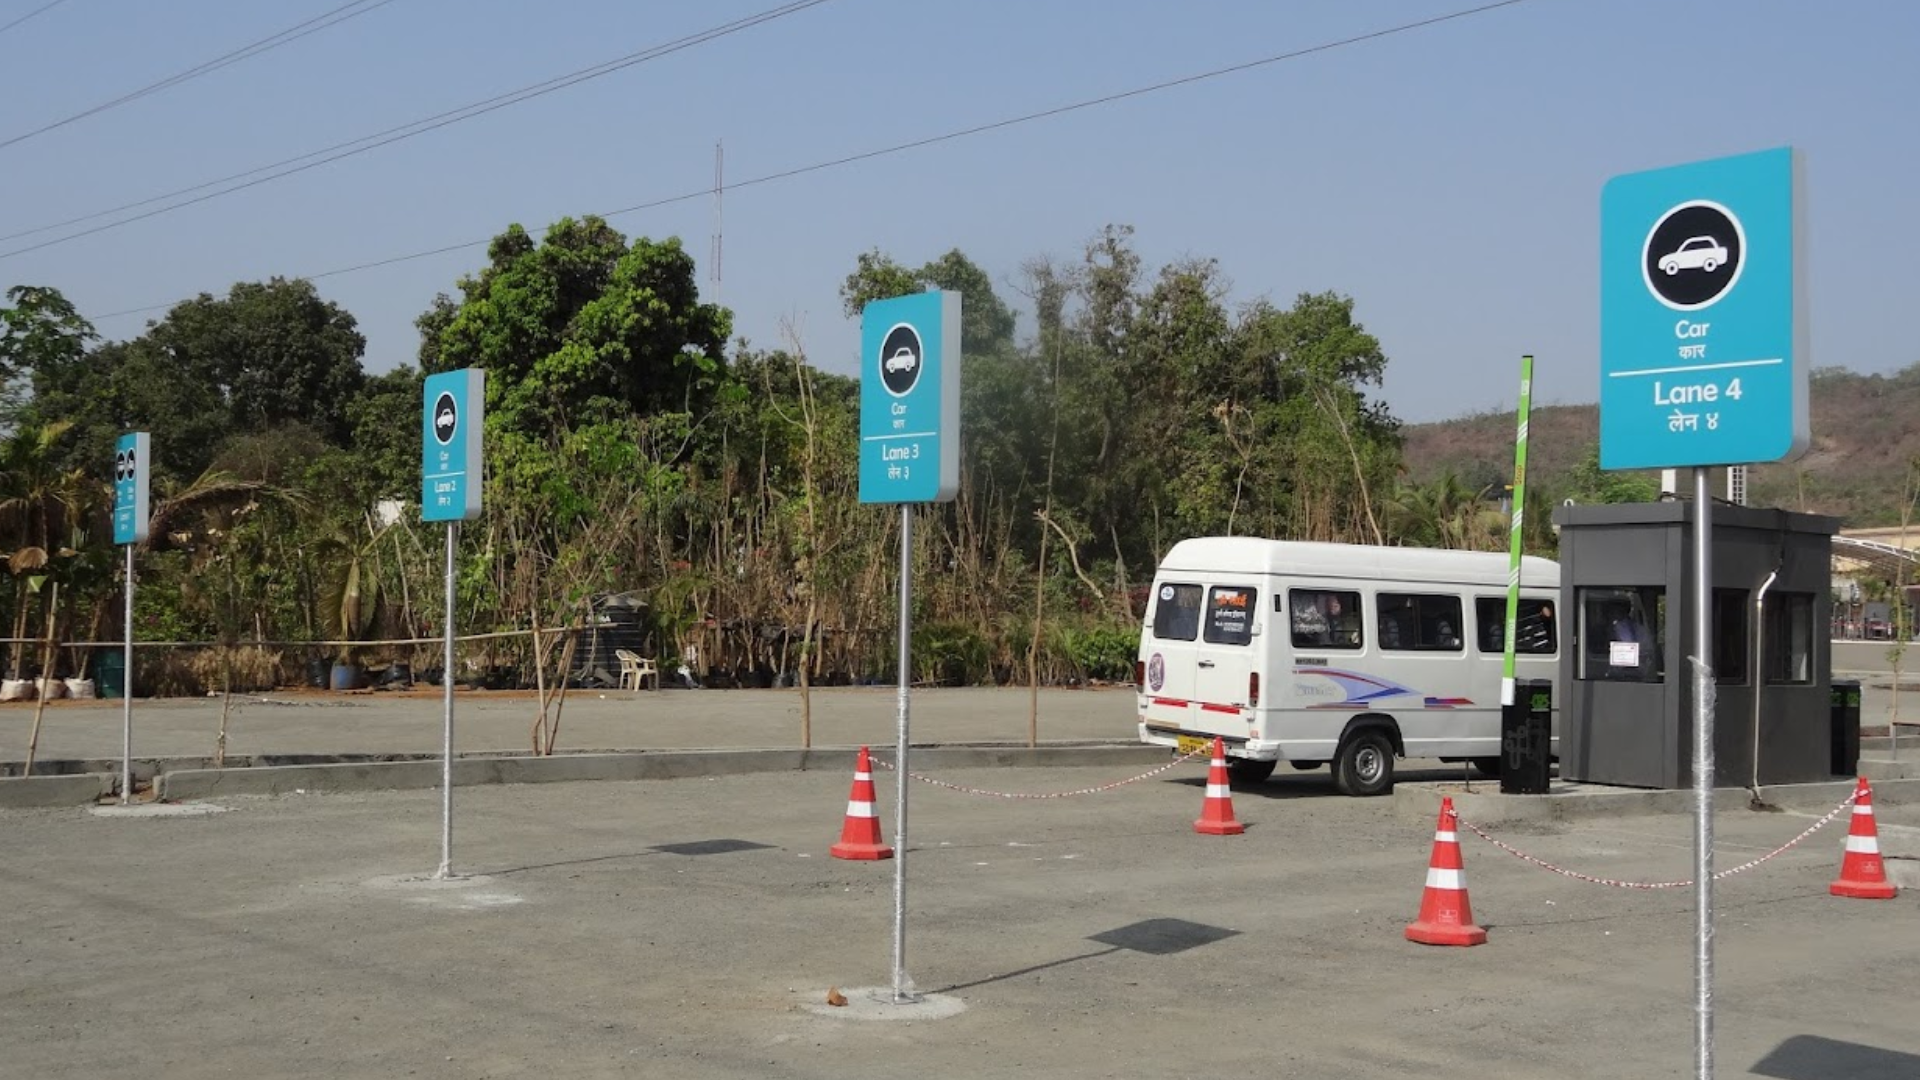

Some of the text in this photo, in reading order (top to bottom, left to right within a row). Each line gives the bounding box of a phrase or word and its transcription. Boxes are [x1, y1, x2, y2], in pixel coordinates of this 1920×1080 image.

[1675, 320, 1710, 339] Car
[1678, 344, 1706, 359] कार
[1654, 377, 1742, 405] Lane 4
[891, 402, 907, 415] Car
[1667, 408, 1719, 432] लेन ४
[882, 443, 919, 461] Lane 3
[451, 480, 456, 491] 2
